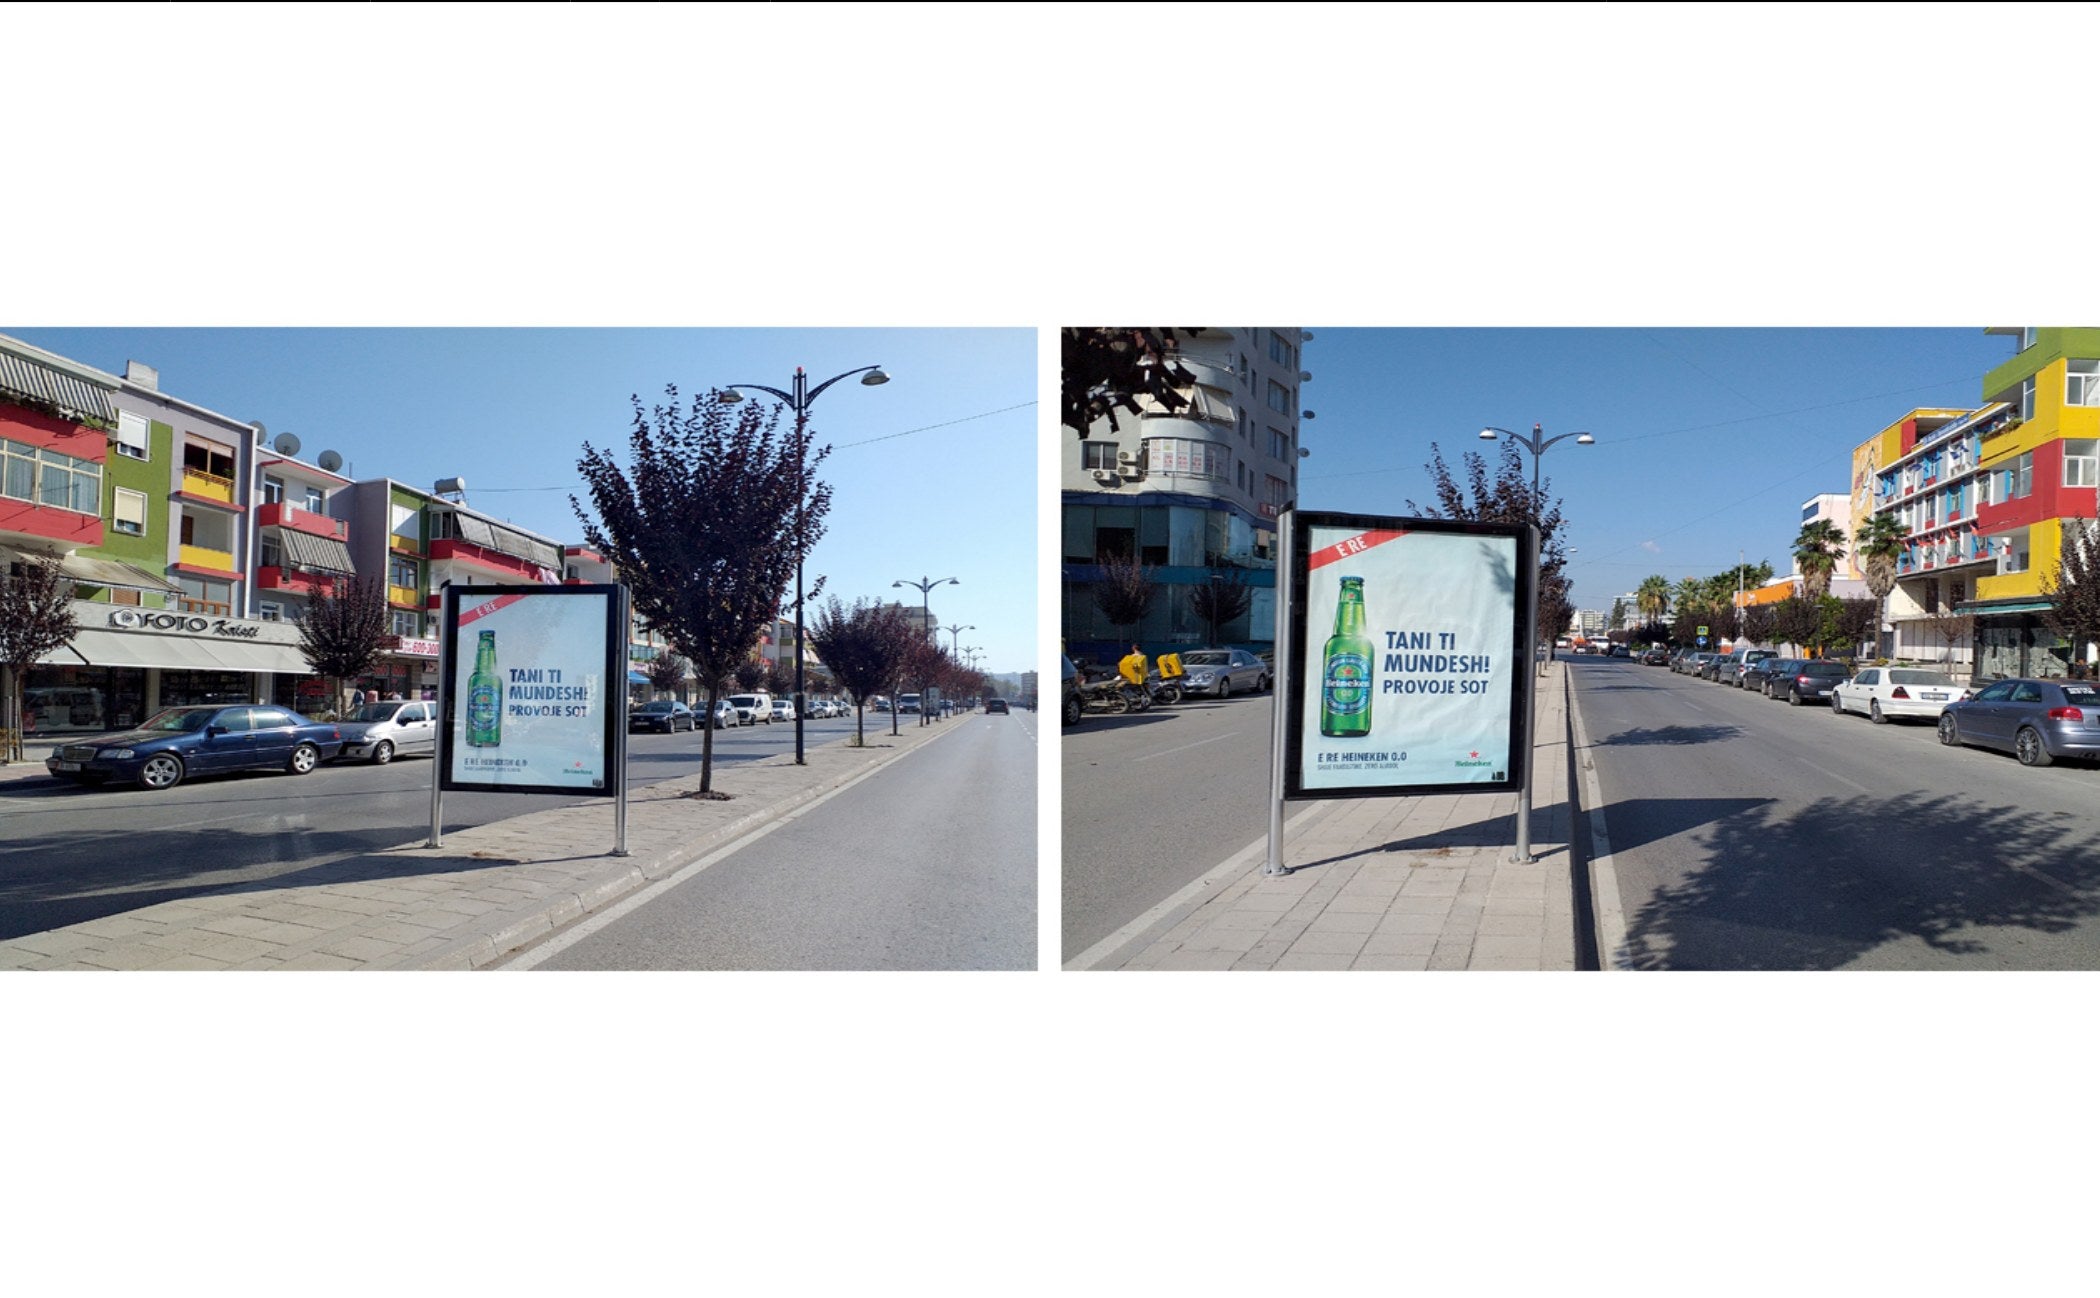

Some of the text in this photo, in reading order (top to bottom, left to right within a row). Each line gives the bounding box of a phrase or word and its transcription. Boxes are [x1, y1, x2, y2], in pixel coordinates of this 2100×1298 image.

[1335, 536, 1367, 557] E RE
[476, 601, 497, 617] E RE
[140, 613, 208, 632] FOTO
[1385, 631, 1455, 650] TANI TI
[1383, 654, 1490, 673] MUNDESH!
[509, 668, 561, 683] TANI TI
[508, 685, 589, 701] MUNDESH!
[1383, 680, 1489, 694] PROVOJE SOT
[509, 705, 562, 717] PROVOJE
[565, 705, 587, 717] SOT
[1326, 752, 1338, 762] RE
[1341, 752, 1389, 762] HEINEKEN
[1391, 751, 1407, 762] 0.0
